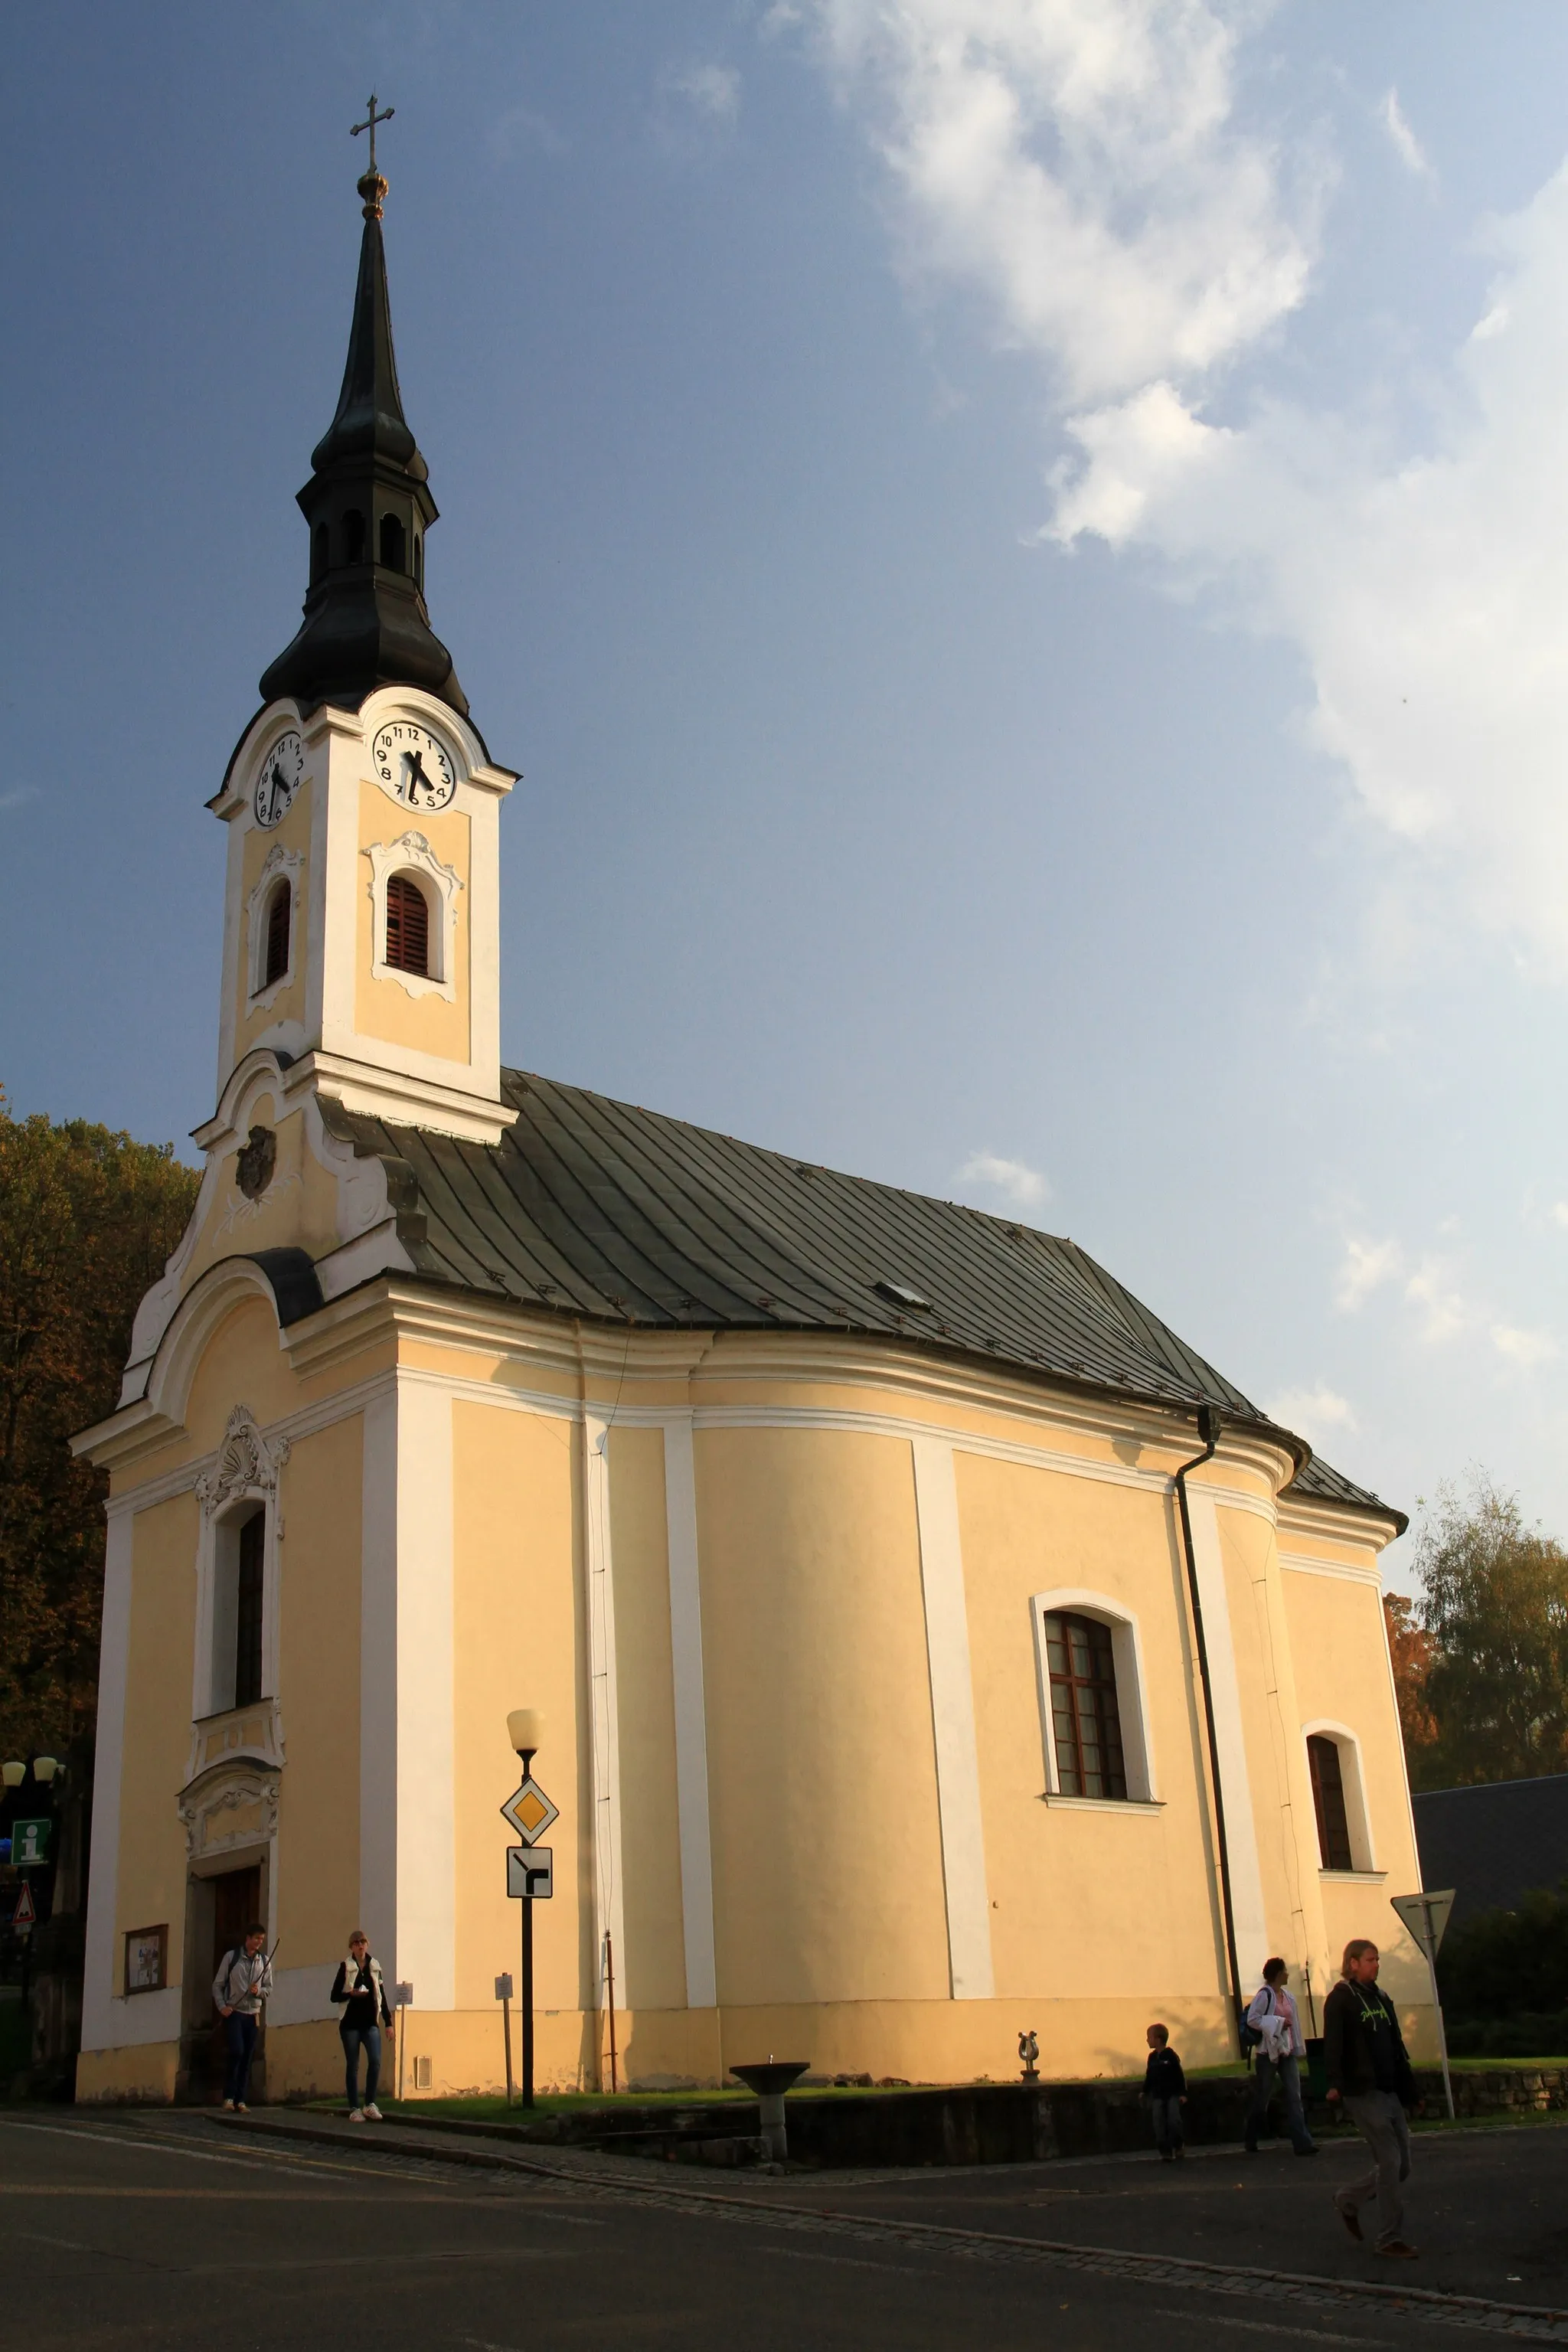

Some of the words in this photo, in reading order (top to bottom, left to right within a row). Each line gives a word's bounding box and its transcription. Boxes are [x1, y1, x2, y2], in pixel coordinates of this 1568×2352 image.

[393, 727, 402, 738] 11
[408, 728, 419, 740] 12
[289, 738, 292, 749] 1
[381, 735, 391, 747] 10
[428, 740, 431, 749] 1
[278, 741, 285, 756] 12
[295, 744, 300, 756] 2
[269, 754, 275, 767] 11
[377, 750, 387, 761] 9
[438, 755, 445, 766] 2
[297, 758, 303, 771] 3
[262, 772, 268, 785] 10
[381, 768, 391, 780] 8
[441, 773, 450, 784] 3
[293, 776, 299, 788] 4
[394, 784, 403, 795] 7
[436, 788, 446, 798] 4
[259, 791, 265, 803] 9
[286, 794, 291, 807] 5
[410, 793, 419, 805] 6
[427, 796, 435, 807] 5
[260, 805, 266, 817] 8
[275, 808, 282, 821] 6
